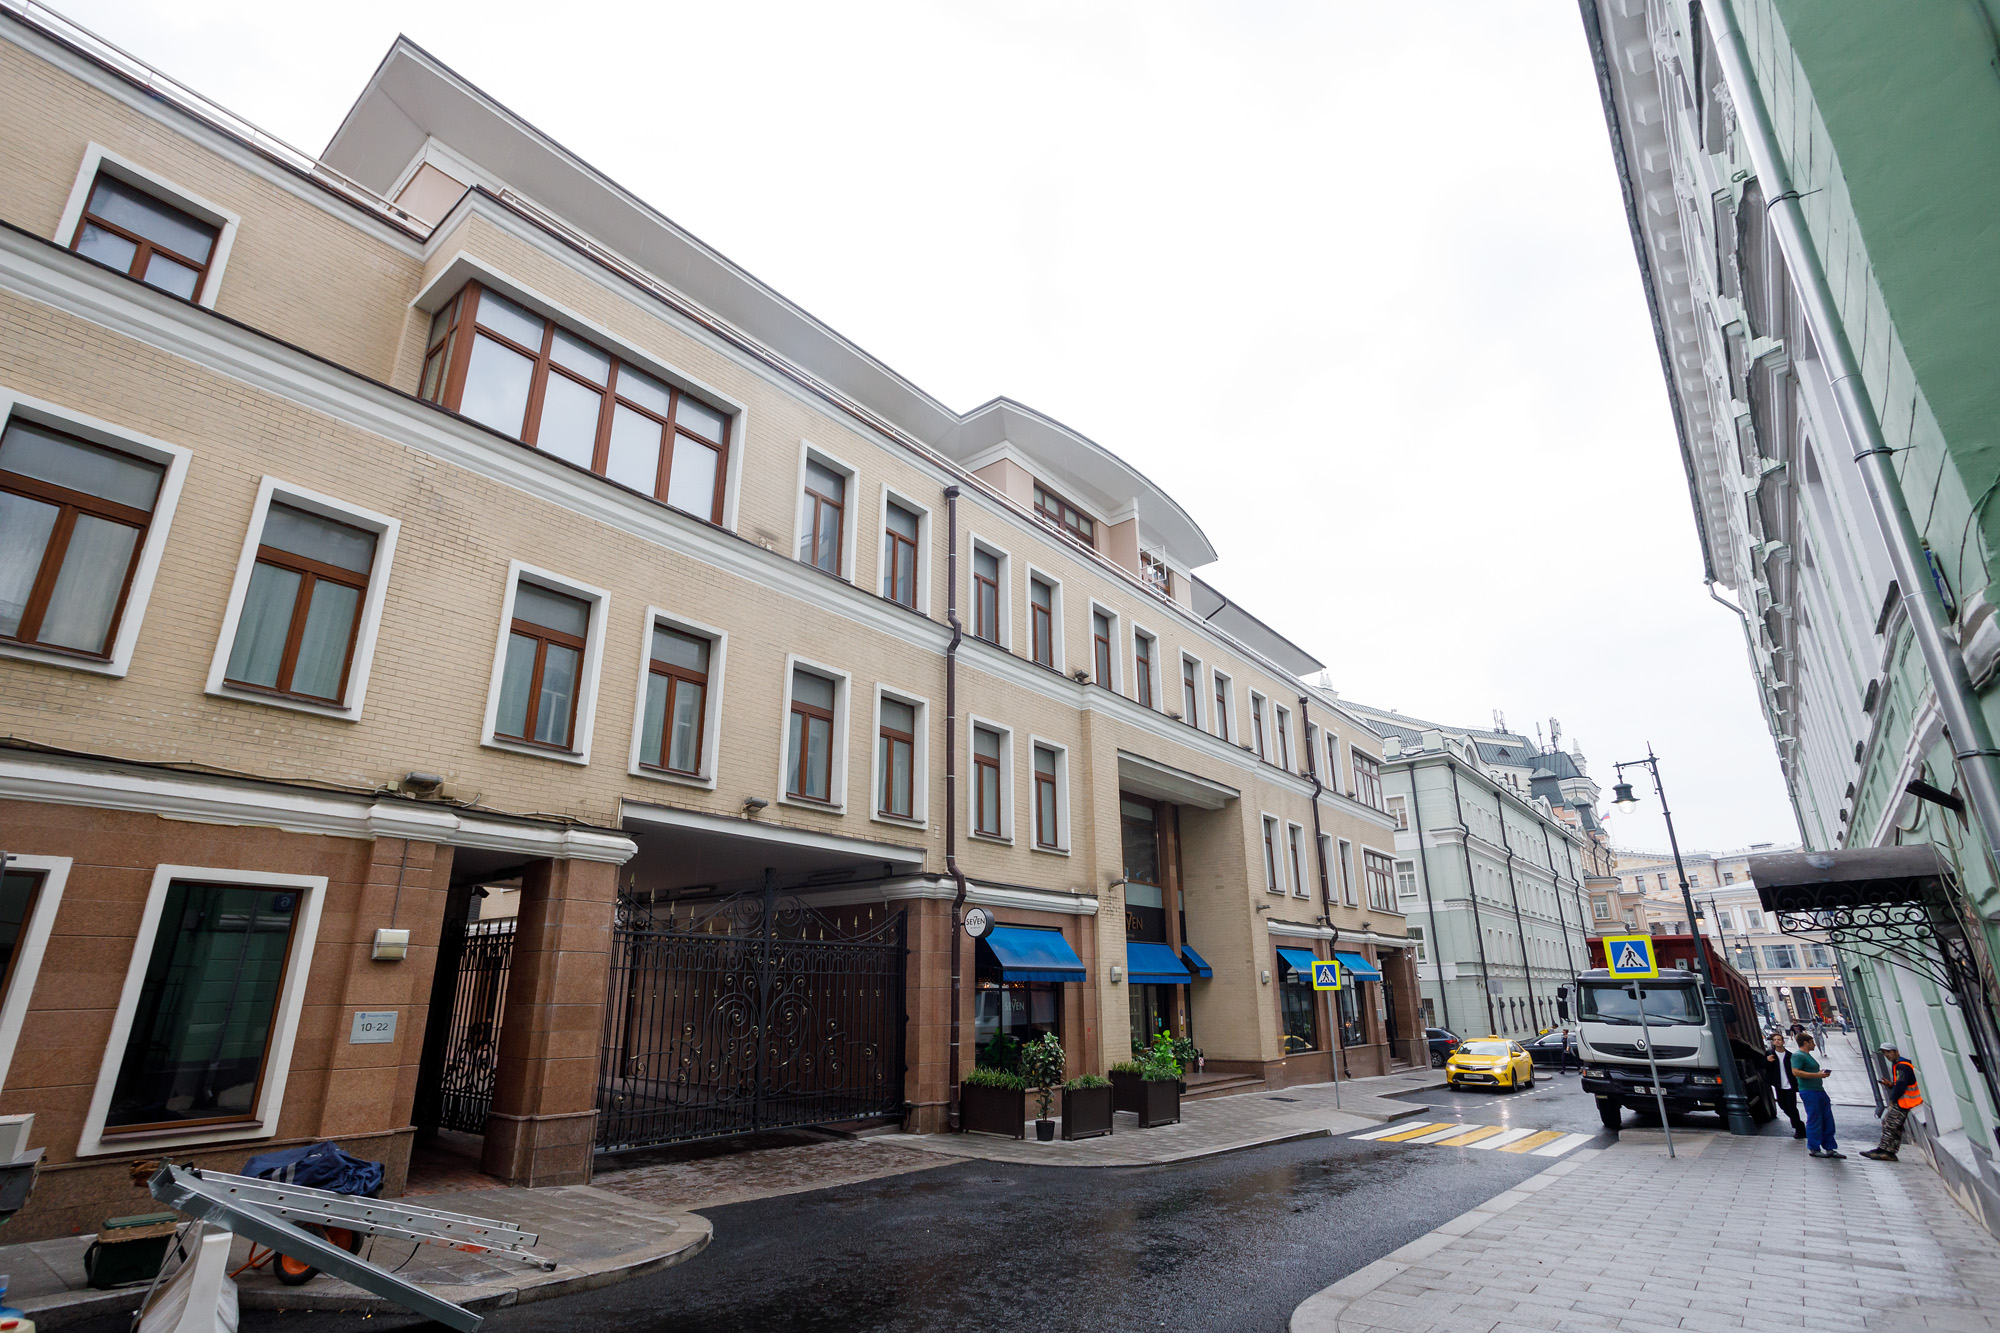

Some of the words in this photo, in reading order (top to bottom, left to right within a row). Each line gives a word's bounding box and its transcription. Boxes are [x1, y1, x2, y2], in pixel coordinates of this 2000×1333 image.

[966, 915, 985, 926] SEVEN
[1126, 911, 1143, 930] VEN
[1005, 999, 1024, 1012] SEVEN
[361, 1022, 388, 1032] 10-22
